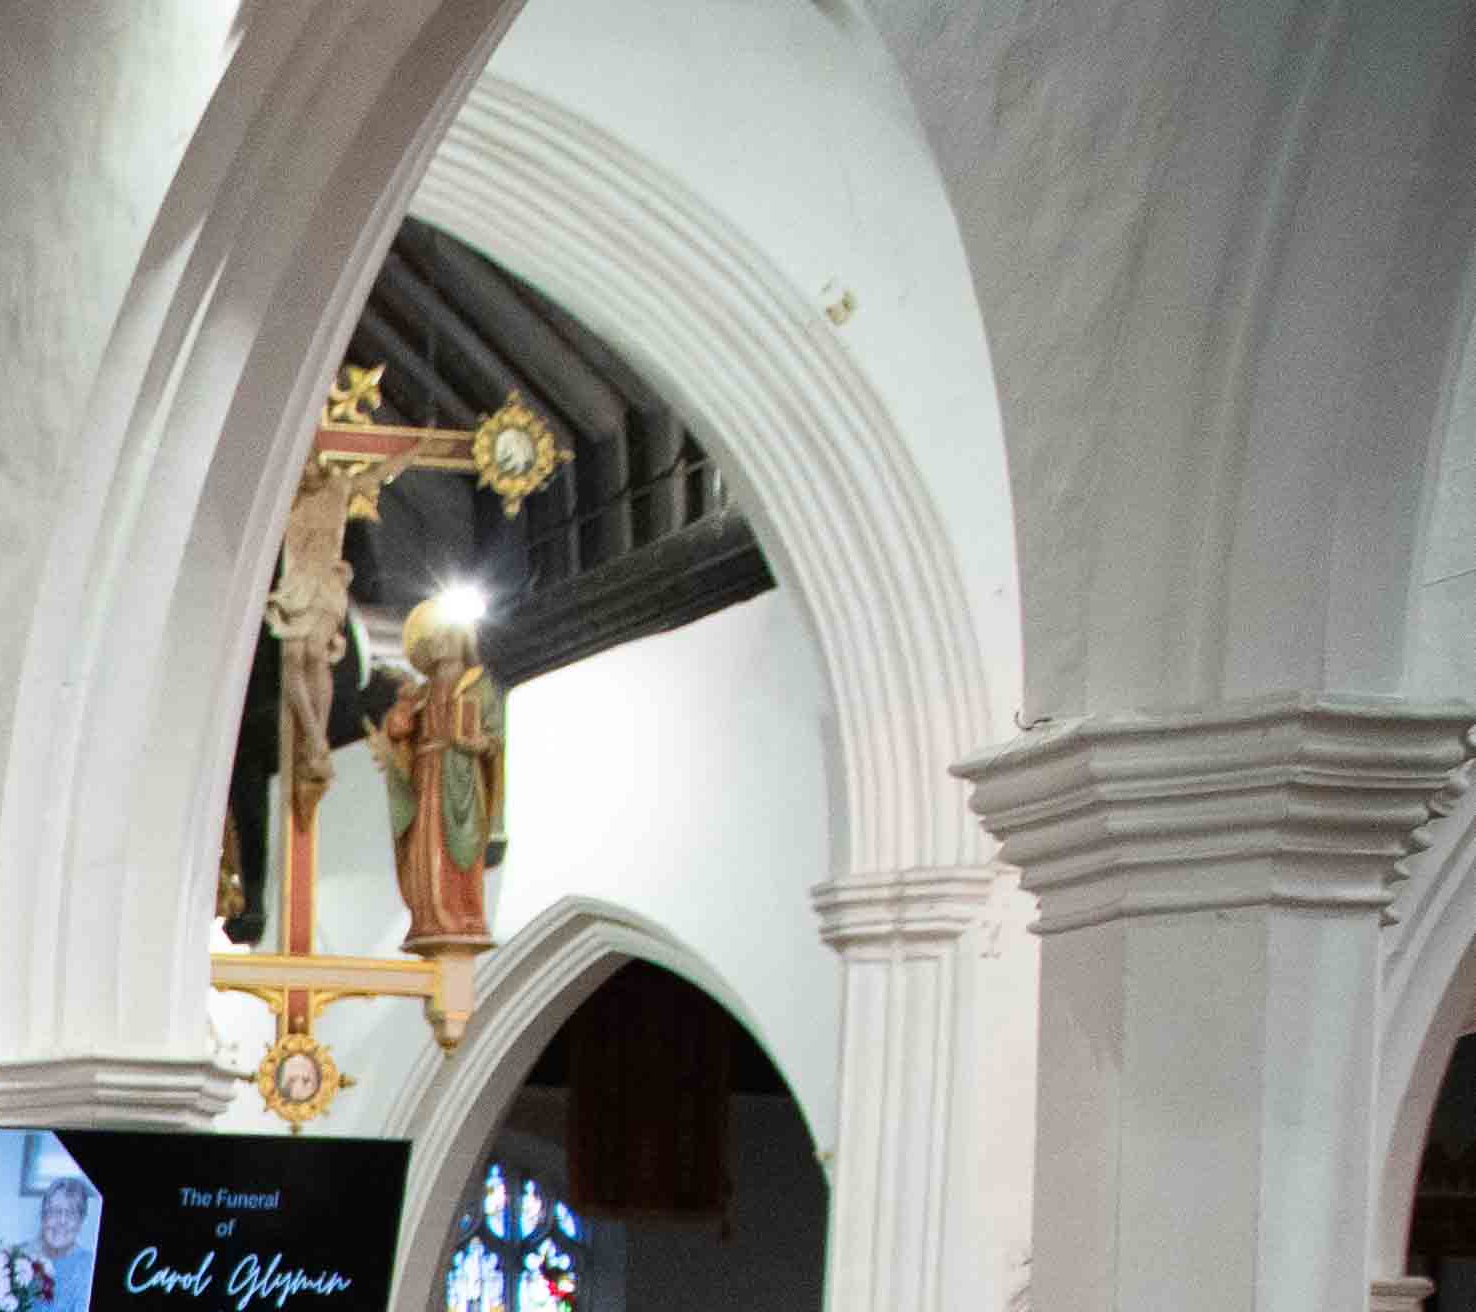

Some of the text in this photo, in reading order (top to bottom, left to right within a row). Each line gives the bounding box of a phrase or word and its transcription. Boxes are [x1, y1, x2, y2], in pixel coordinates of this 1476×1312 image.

[179, 1187, 281, 1209] The Funeral
[216, 1218, 237, 1238] of
[127, 1246, 216, 1296] Carol
